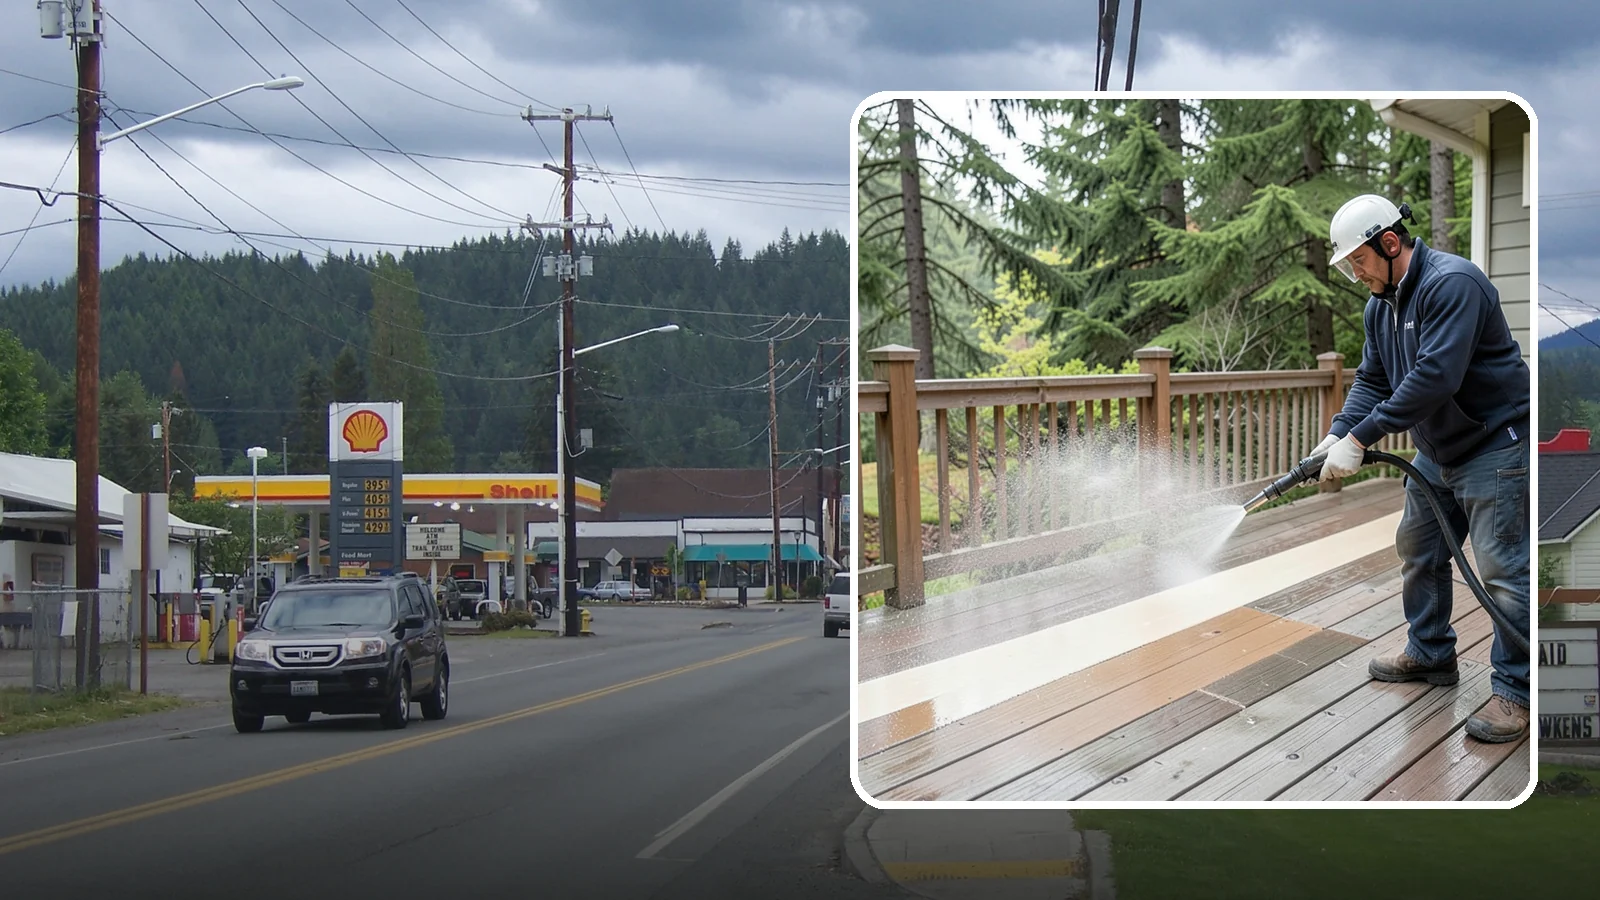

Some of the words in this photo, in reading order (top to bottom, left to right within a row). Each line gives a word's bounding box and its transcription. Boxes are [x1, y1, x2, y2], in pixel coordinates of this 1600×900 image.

[366, 480, 383, 490] 395
[490, 484, 547, 499] Shell
[366, 494, 383, 504] 405
[366, 508, 383, 518] 415
[366, 522, 383, 532] 429
[1538, 643, 1567, 665] AID
